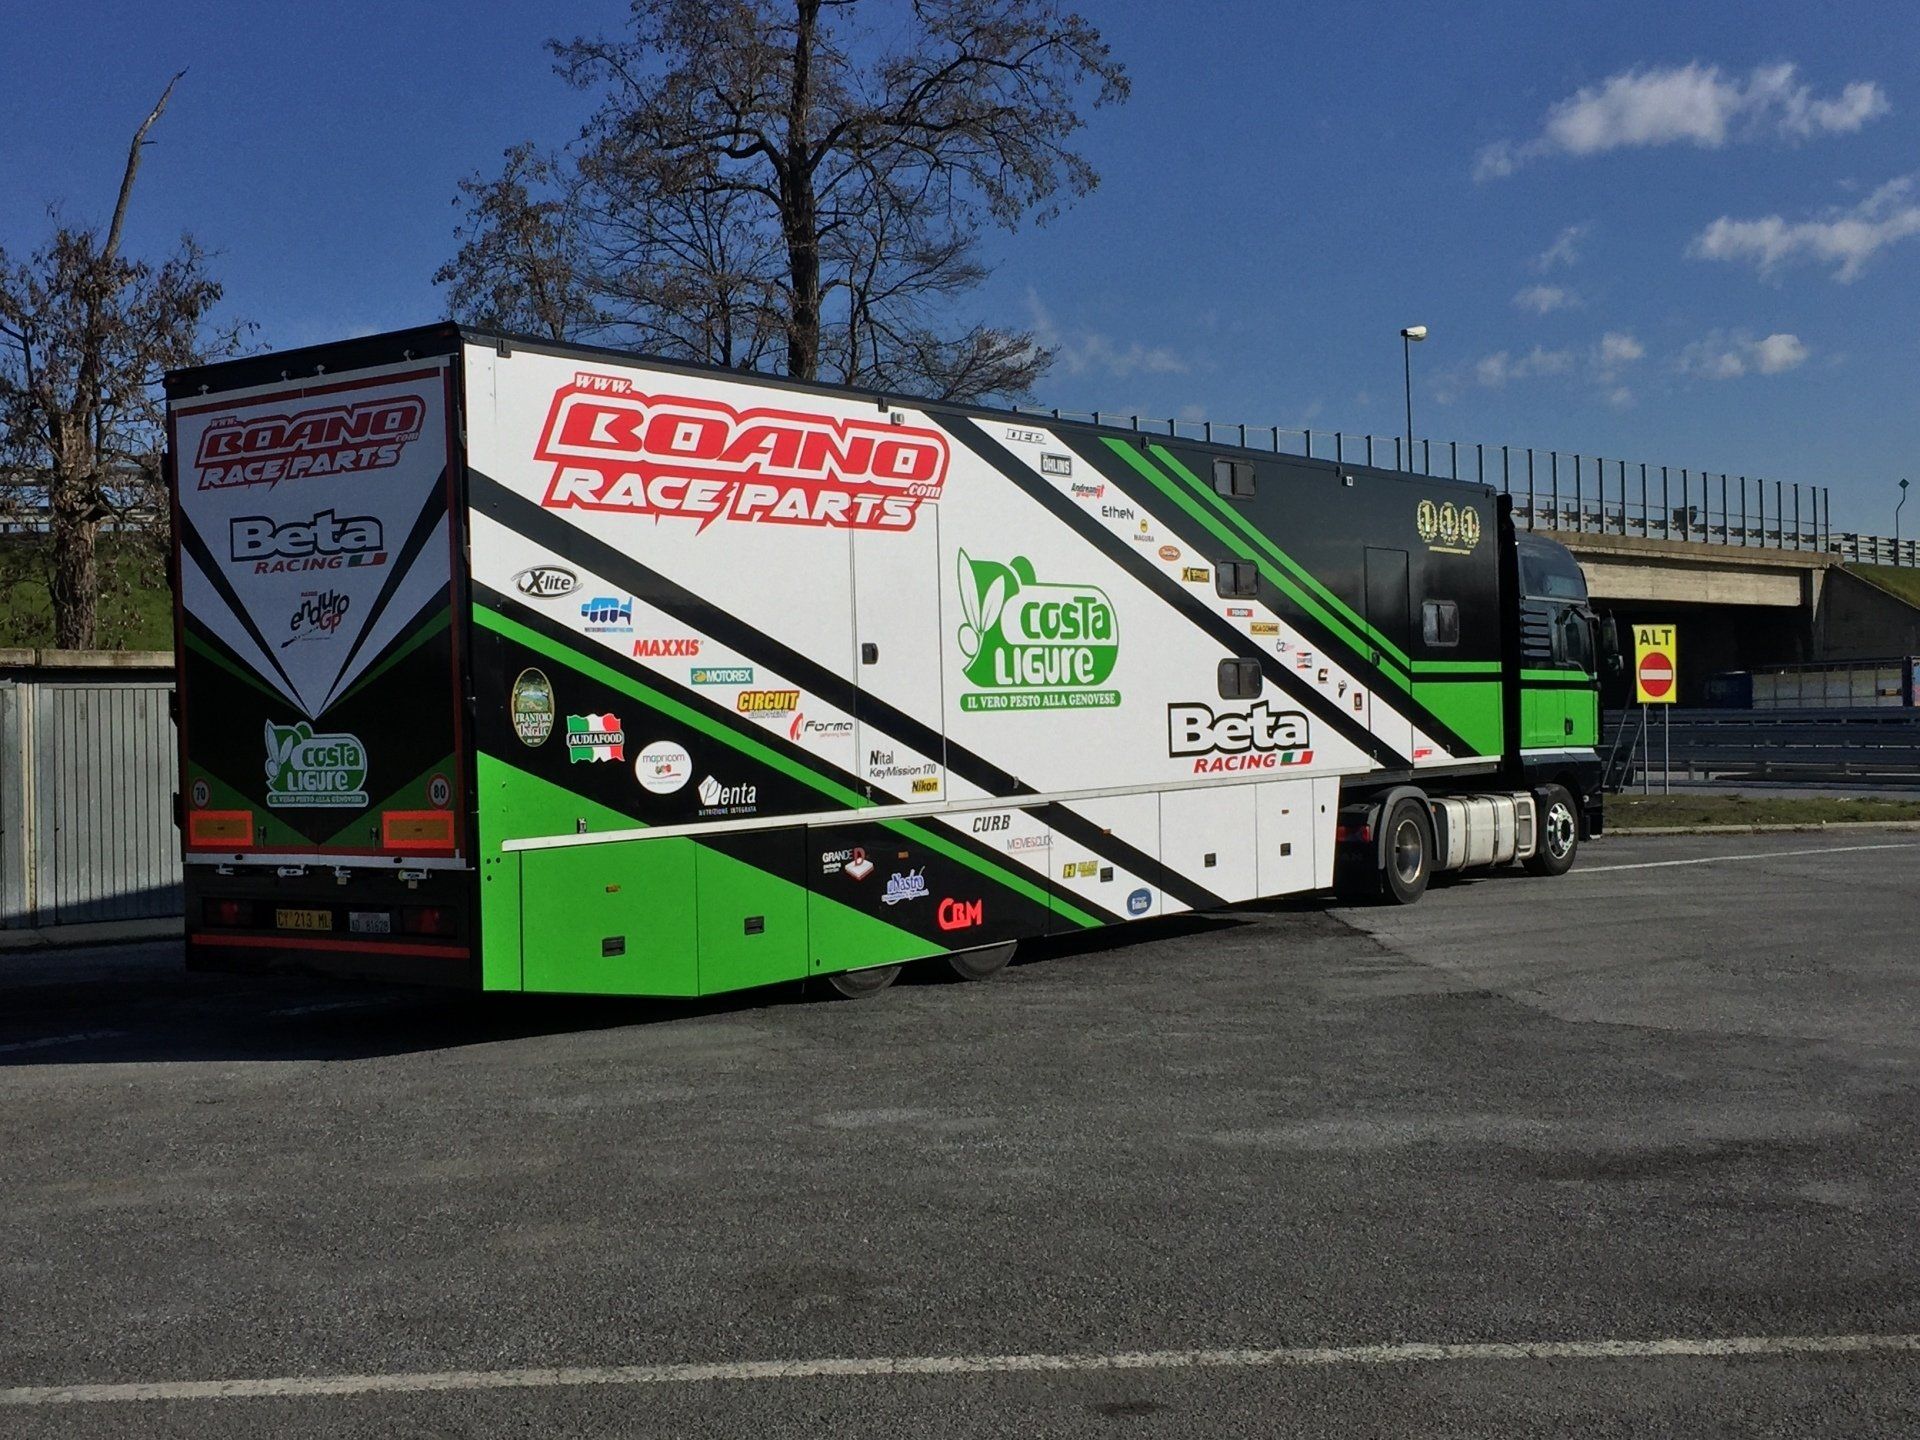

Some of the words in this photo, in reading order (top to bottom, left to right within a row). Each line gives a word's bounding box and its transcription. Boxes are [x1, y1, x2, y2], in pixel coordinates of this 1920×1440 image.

[203, 404, 418, 459] BOANO
[1006, 428, 1045, 444] DEP
[557, 402, 939, 482] BOANO
[201, 458, 284, 490] RACE
[289, 446, 398, 477] PARTS
[551, 467, 719, 513] RACE
[735, 485, 914, 525] PARTS
[903, 483, 943, 498] .com
[230, 509, 383, 562] Beta
[254, 556, 342, 574] RACING
[290, 589, 349, 632] enduro
[1639, 629, 1672, 646] ALT
[632, 639, 700, 657] MAXXIS
[706, 669, 752, 683] MOTOREX
[737, 690, 800, 713] CIRCUIT
[967, 696, 978, 709] IL
[980, 695, 1008, 709] VERO
[1010, 694, 1041, 708] PESTO
[1042, 694, 1068, 707] ALLA
[1069, 692, 1116, 706] GENOVESE
[804, 720, 853, 733] Forma
[1168, 700, 1309, 758] Beta
[570, 733, 622, 745] AUDIAFOOD
[870, 750, 894, 765] Nital
[1194, 752, 1277, 773] RACING
[869, 764, 921, 778] KeyMission
[922, 763, 936, 775] 170
[195, 786, 206, 801] 70
[433, 784, 446, 800] 80
[912, 779, 938, 793] Nikon
[973, 815, 1011, 832] CURB
[822, 849, 854, 863] GRANDE
[295, 912, 313, 927] 213
